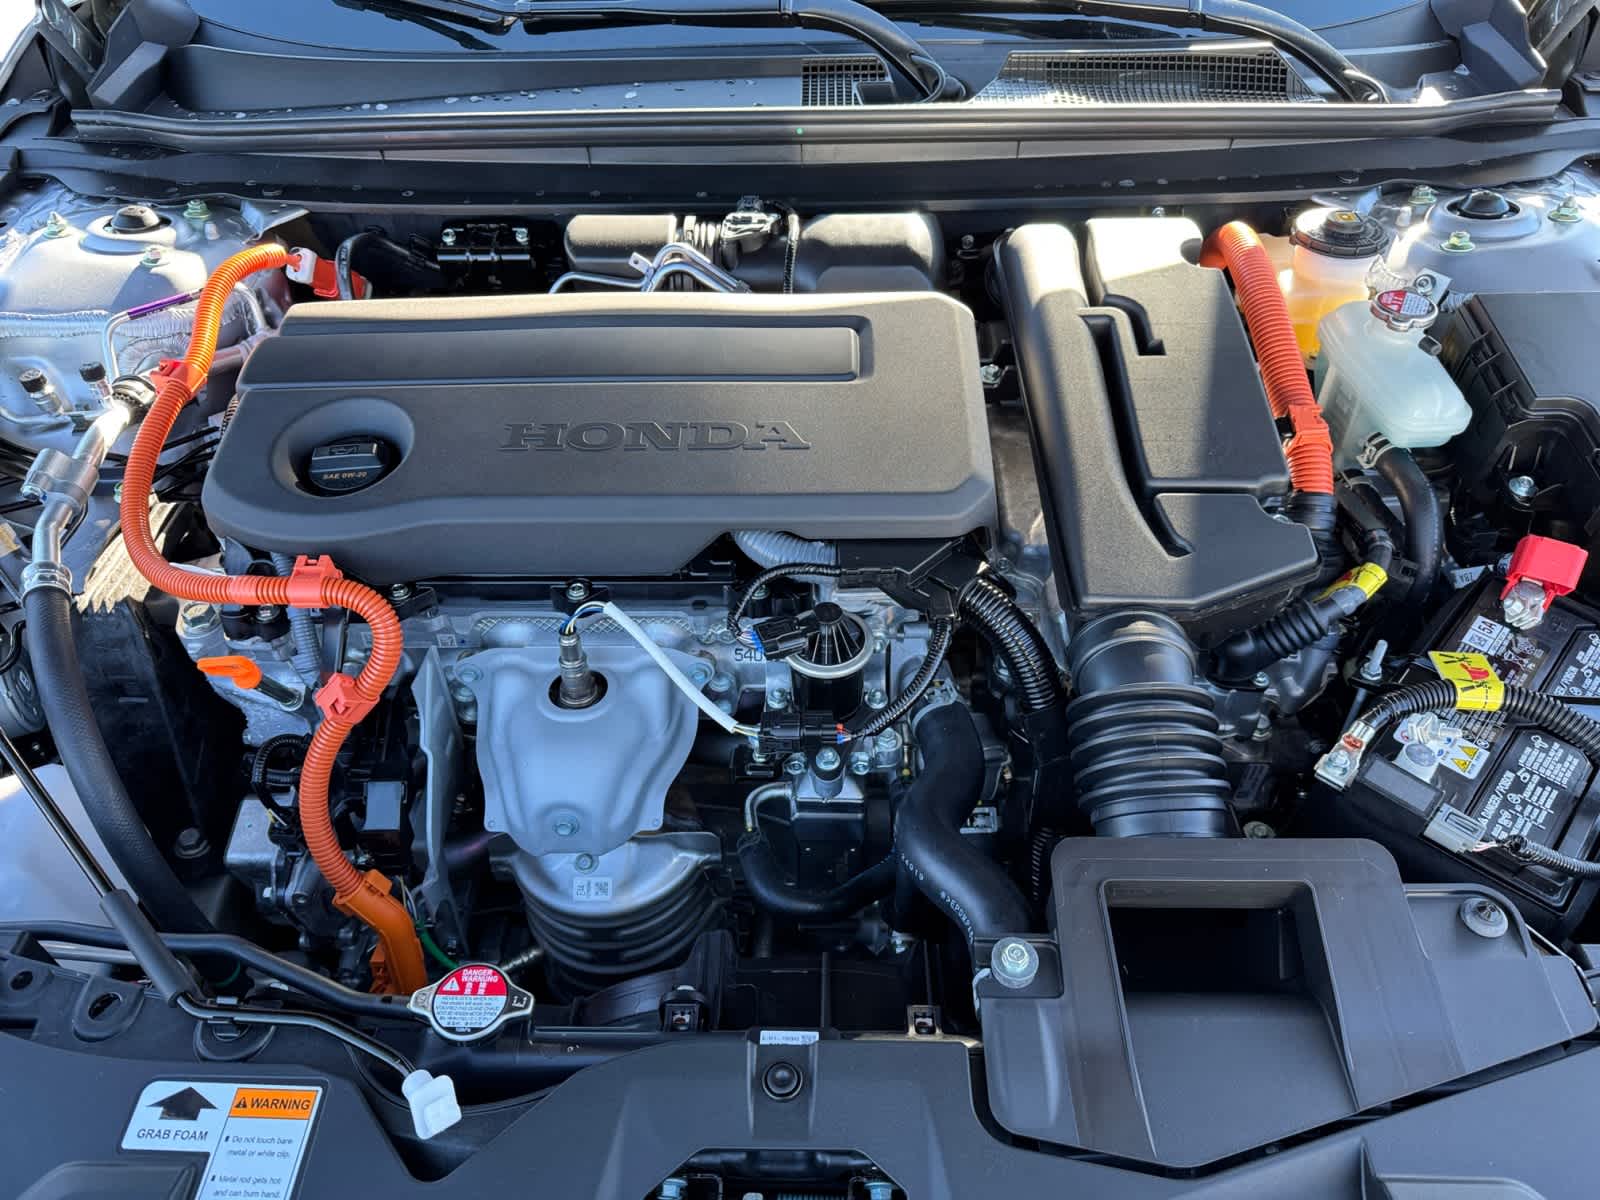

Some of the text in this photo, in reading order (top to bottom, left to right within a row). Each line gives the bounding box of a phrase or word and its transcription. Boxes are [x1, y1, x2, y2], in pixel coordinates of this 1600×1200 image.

[499, 420, 812, 451] HONDA
[462, 968, 495, 977] DANGER
[250, 1098, 311, 1111] WARNING
[136, 1128, 209, 1142] GRAB FOAM
[232, 1135, 293, 1145] Do not touch bare
[227, 1149, 248, 1158] metal
[257, 1149, 276, 1158] white
[219, 1175, 282, 1185] Metal rod gets hot
[213, 1189, 229, 1197] and
[243, 1190, 260, 1198] burn
